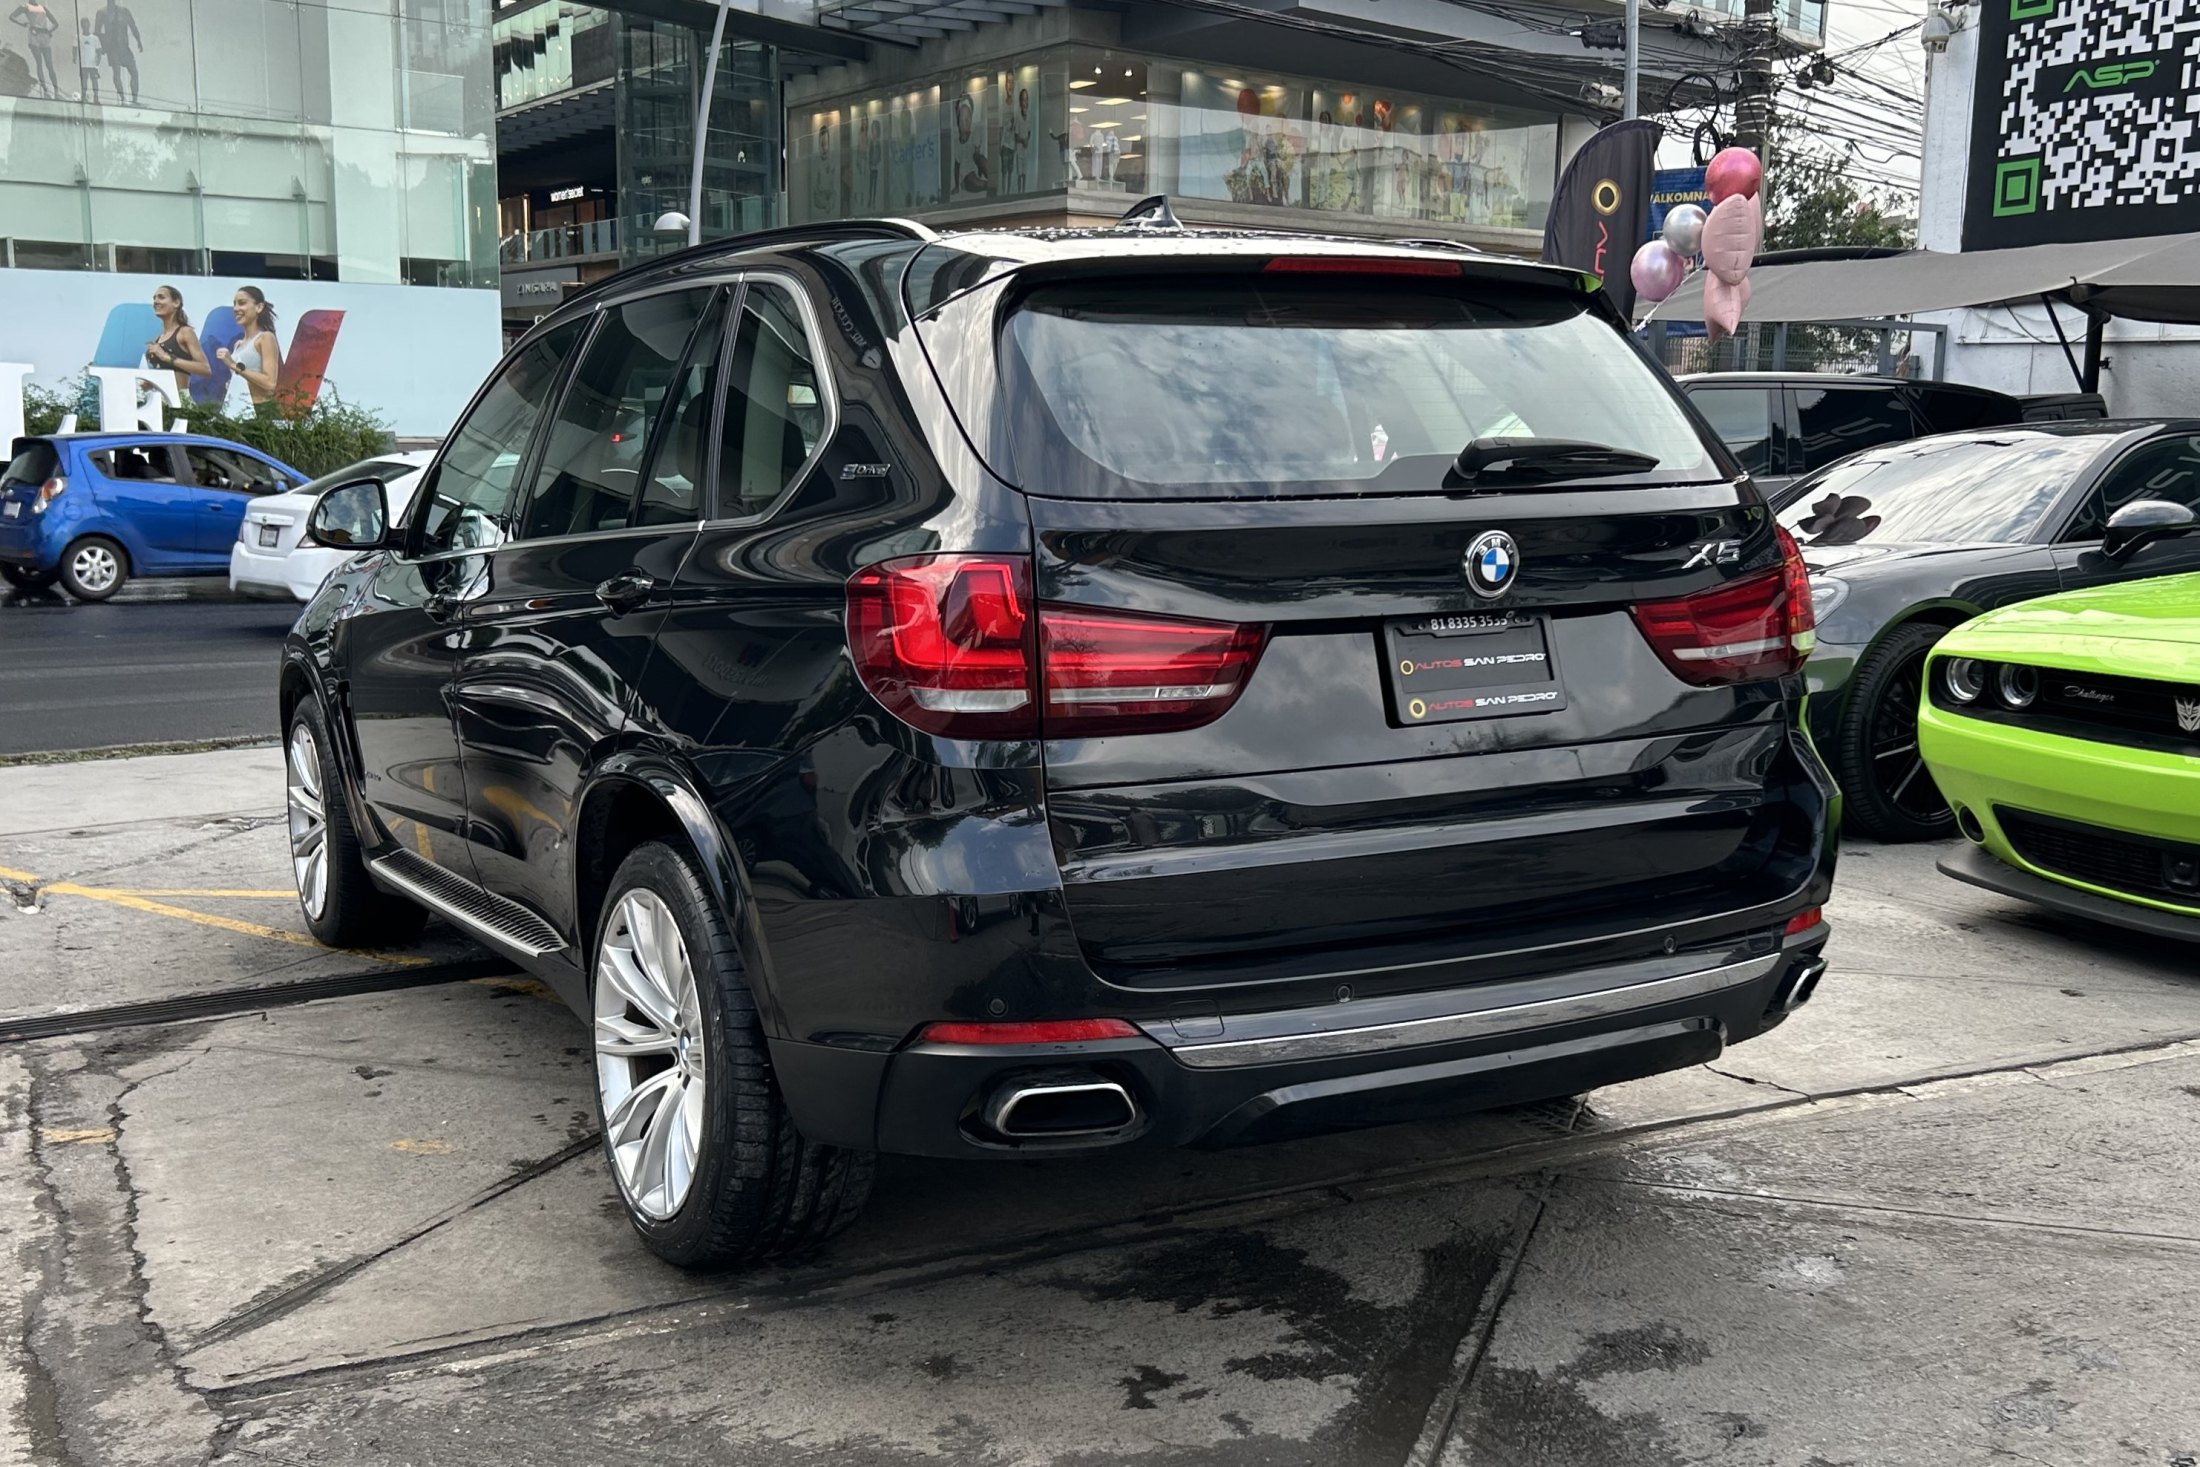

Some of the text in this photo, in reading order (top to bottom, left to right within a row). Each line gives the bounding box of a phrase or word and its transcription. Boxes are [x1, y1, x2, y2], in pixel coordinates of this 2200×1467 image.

[2063, 60, 2155, 93] ASP
[1681, 539, 1742, 569] X5
[1431, 618, 1446, 631] 81
[1447, 616, 1477, 630] 8335
[1414, 653, 1545, 671] AUTOS SAN PEDRO
[1428, 692, 1557, 711] AUTOS SAN PEDRO
[2064, 685, 2115, 703] Challenger
